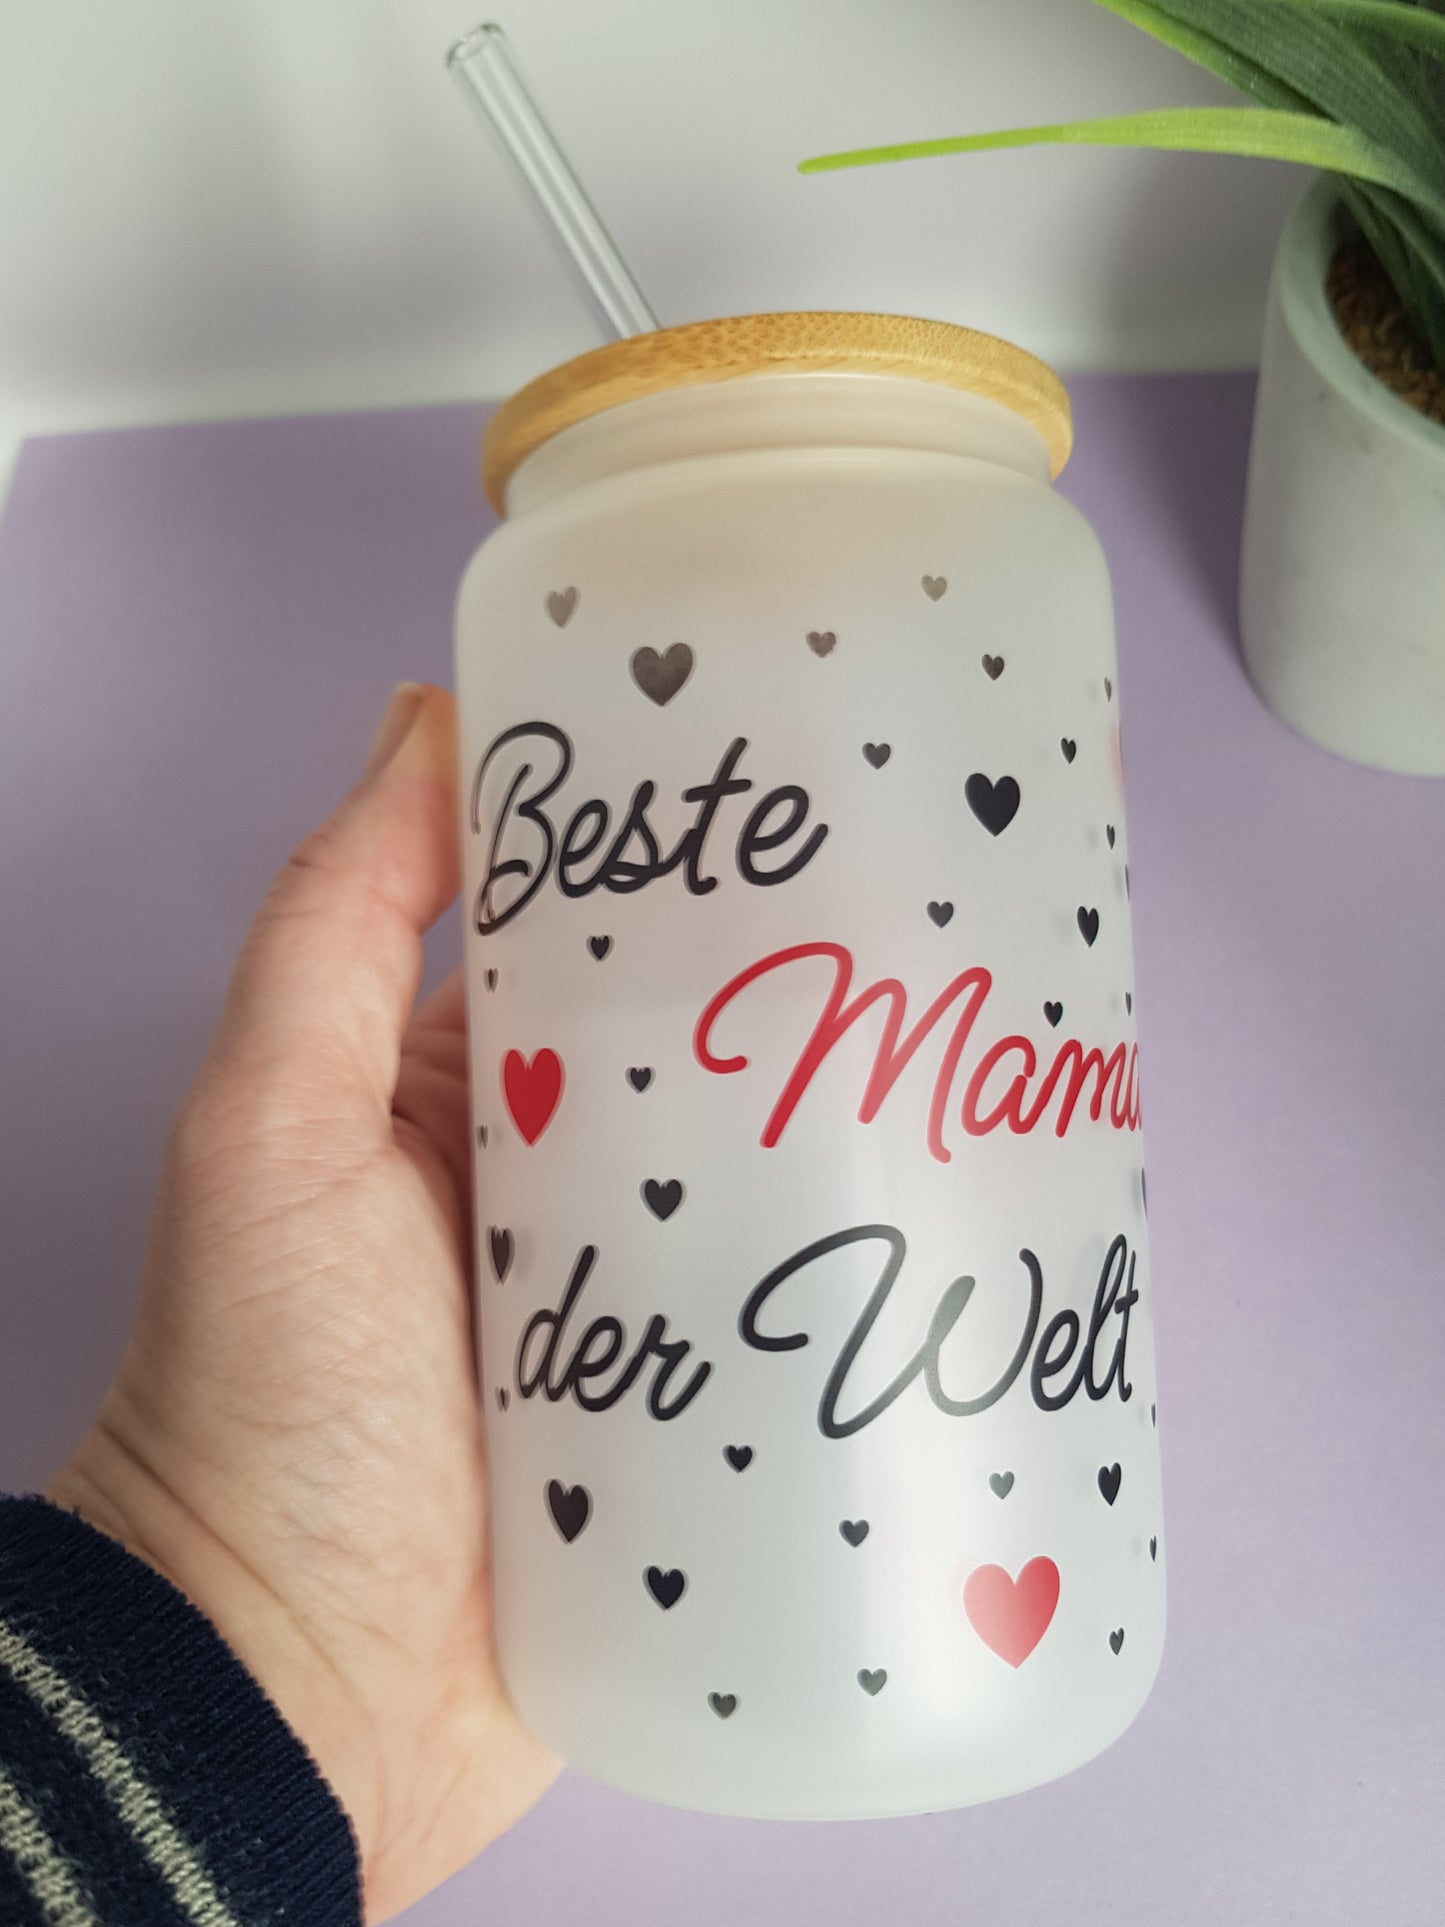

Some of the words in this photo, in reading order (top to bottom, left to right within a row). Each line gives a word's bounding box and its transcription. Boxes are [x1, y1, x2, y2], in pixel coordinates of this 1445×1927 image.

[474, 721, 829, 936] Beste
[516, 1244, 711, 1422] der
[737, 1223, 1139, 1439] Welt
